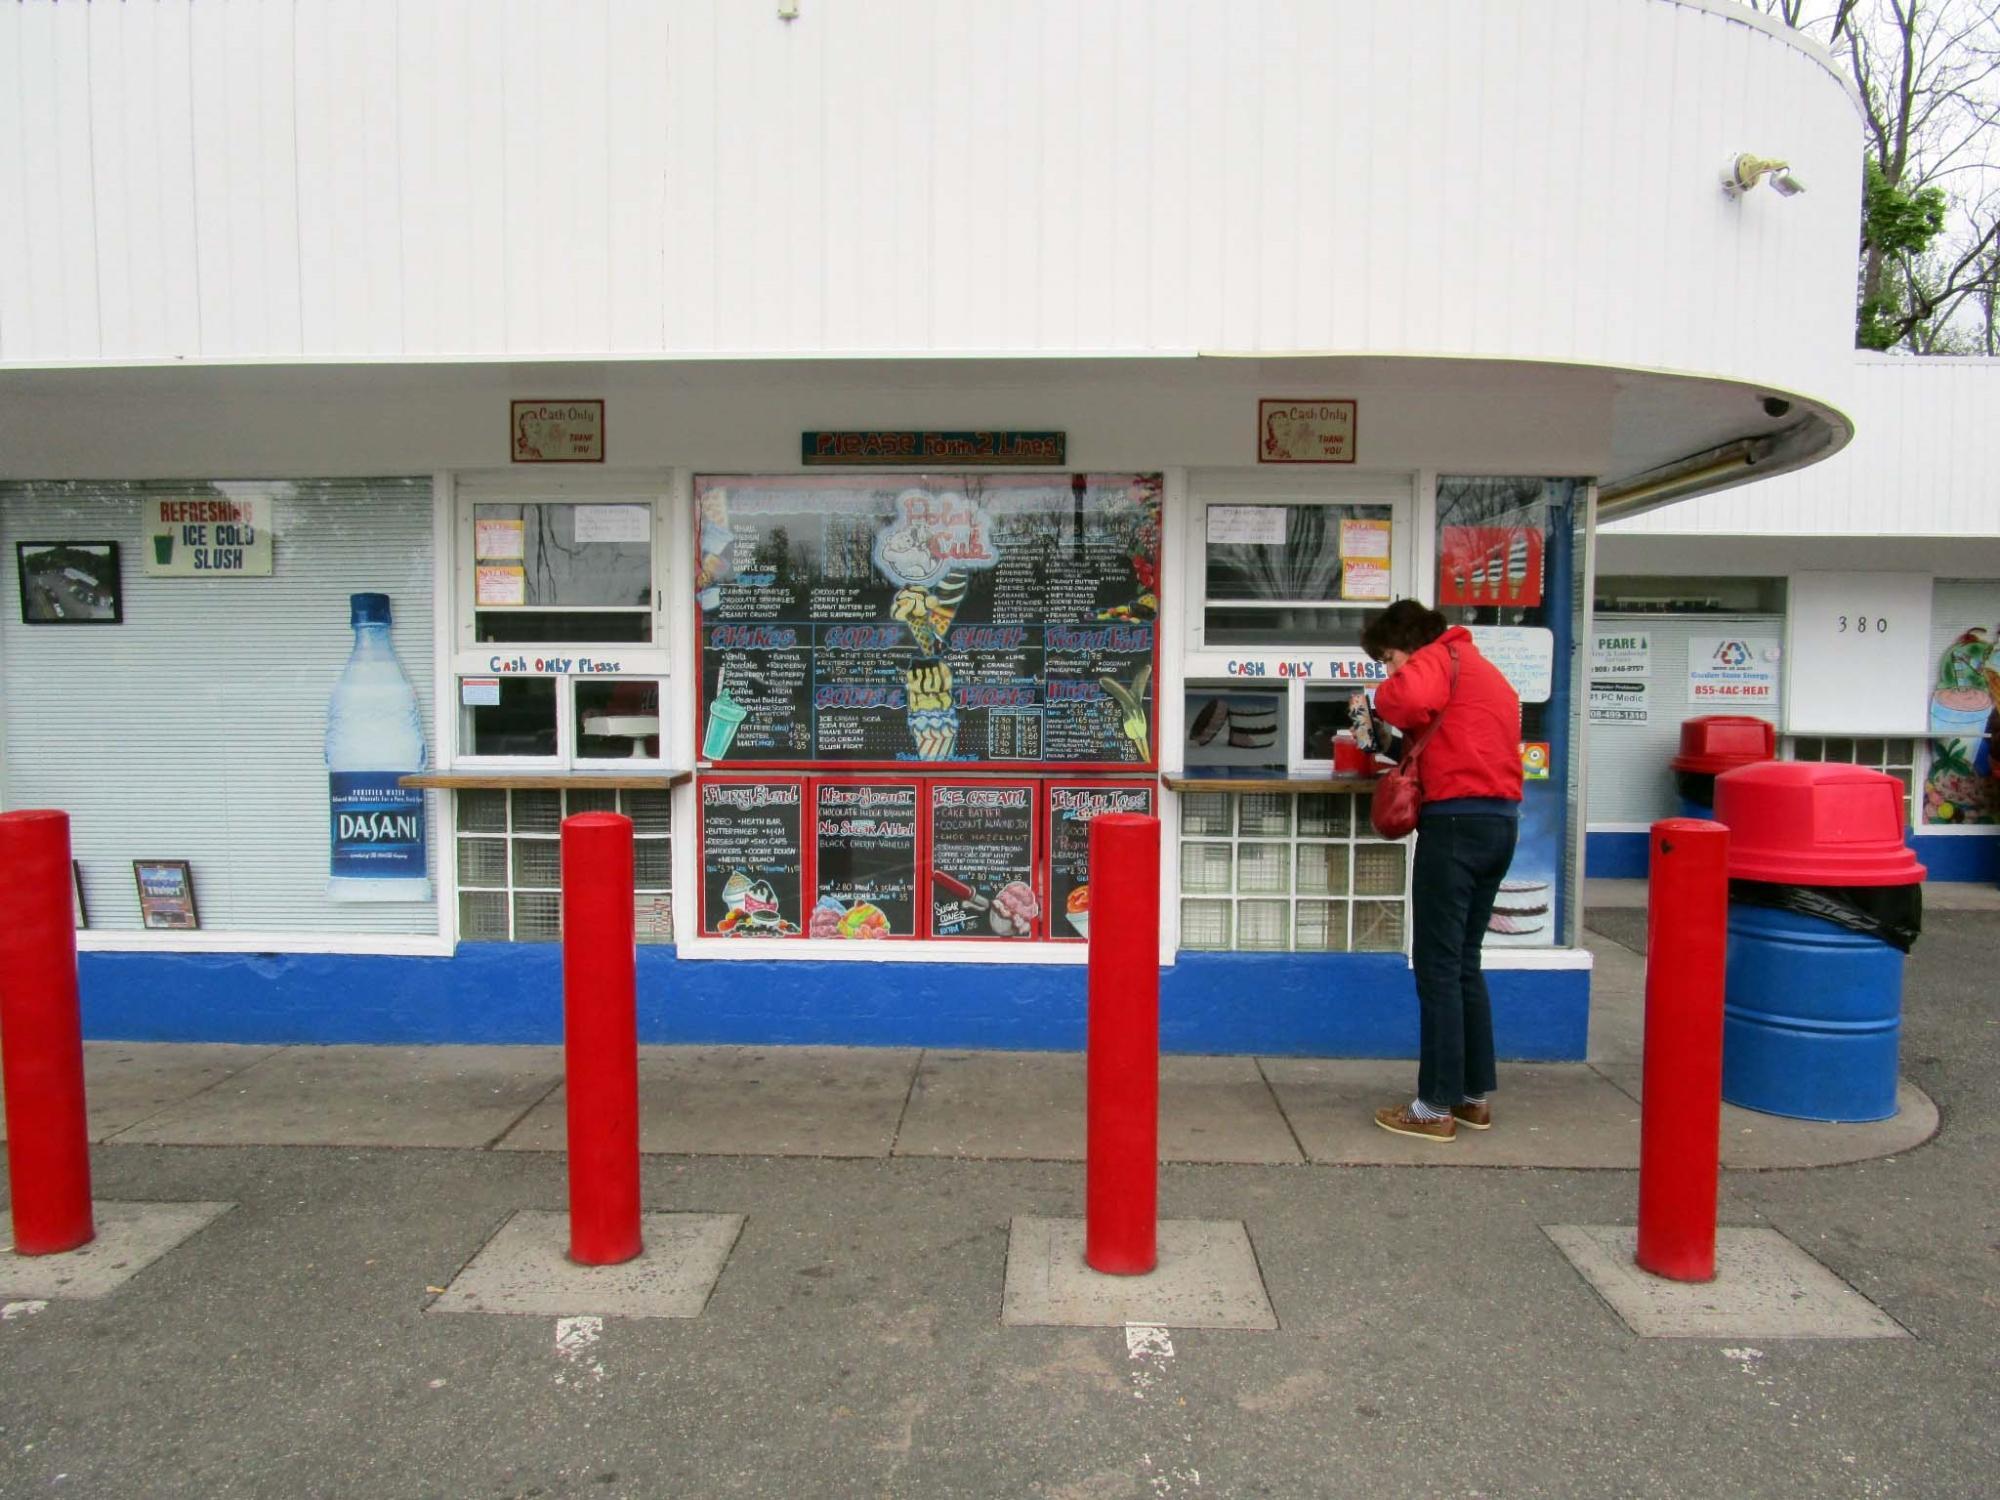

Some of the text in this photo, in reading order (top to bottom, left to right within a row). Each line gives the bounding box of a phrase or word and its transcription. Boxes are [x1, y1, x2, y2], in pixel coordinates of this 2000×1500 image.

[539, 407, 594, 422] Cash Only
[1289, 407, 1347, 423] Cash Only
[569, 433, 594, 442] THANK
[975, 432, 993, 455] 2
[1319, 434, 1344, 443] THANK
[573, 445, 590, 453] YOU
[1324, 446, 1342, 454] YOU
[160, 501, 253, 522] REFRESHING
[183, 525, 254, 546] ICE COLD
[194, 549, 243, 569] SLUSH
[1598, 638, 1636, 649] PEARE
[535, 658, 572, 672] ONLY
[1228, 660, 1386, 678] CASH ONLY PLEASE
[1616, 694, 1643, 702] Medic
[1695, 685, 1770, 696] 855-4AC-HEAT
[967, 790, 1027, 808] CREAM
[340, 812, 417, 842] DASANI
